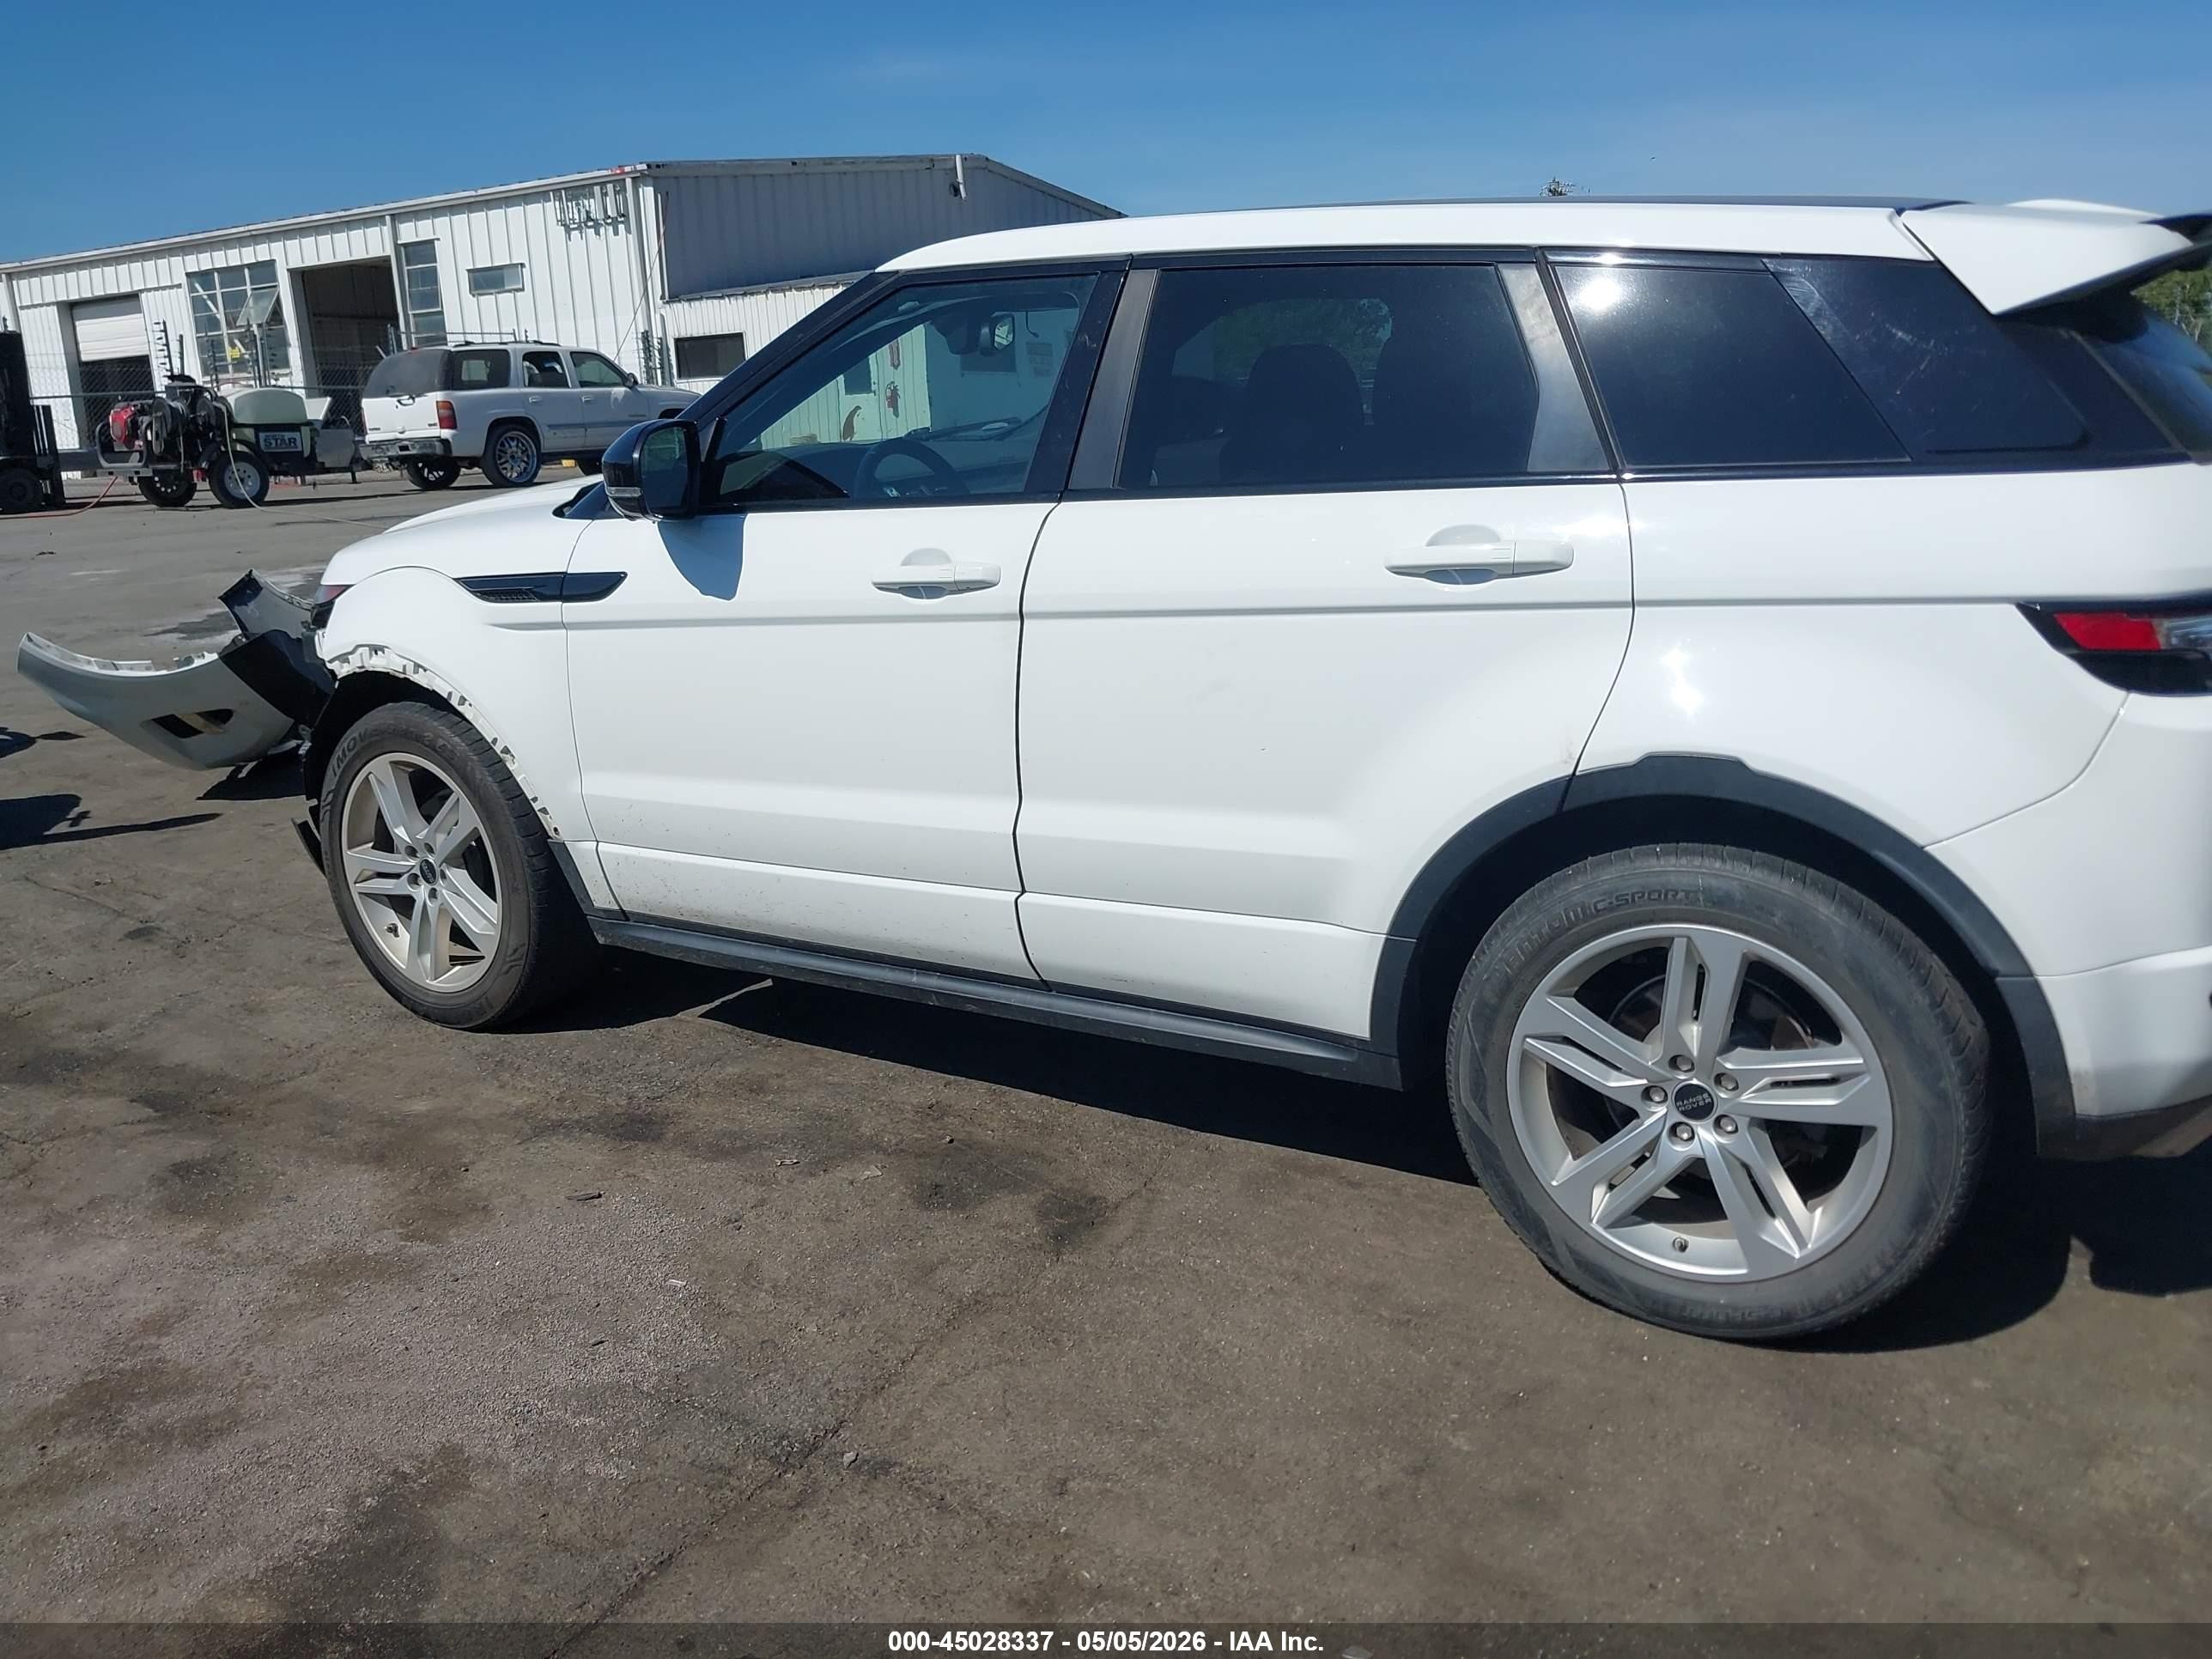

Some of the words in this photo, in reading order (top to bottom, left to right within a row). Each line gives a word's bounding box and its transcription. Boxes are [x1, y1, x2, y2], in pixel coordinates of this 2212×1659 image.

[264, 437, 299, 448] STAR
[1676, 1092, 1710, 1107] RANGE
[1678, 1097, 1712, 1111] ROVER
